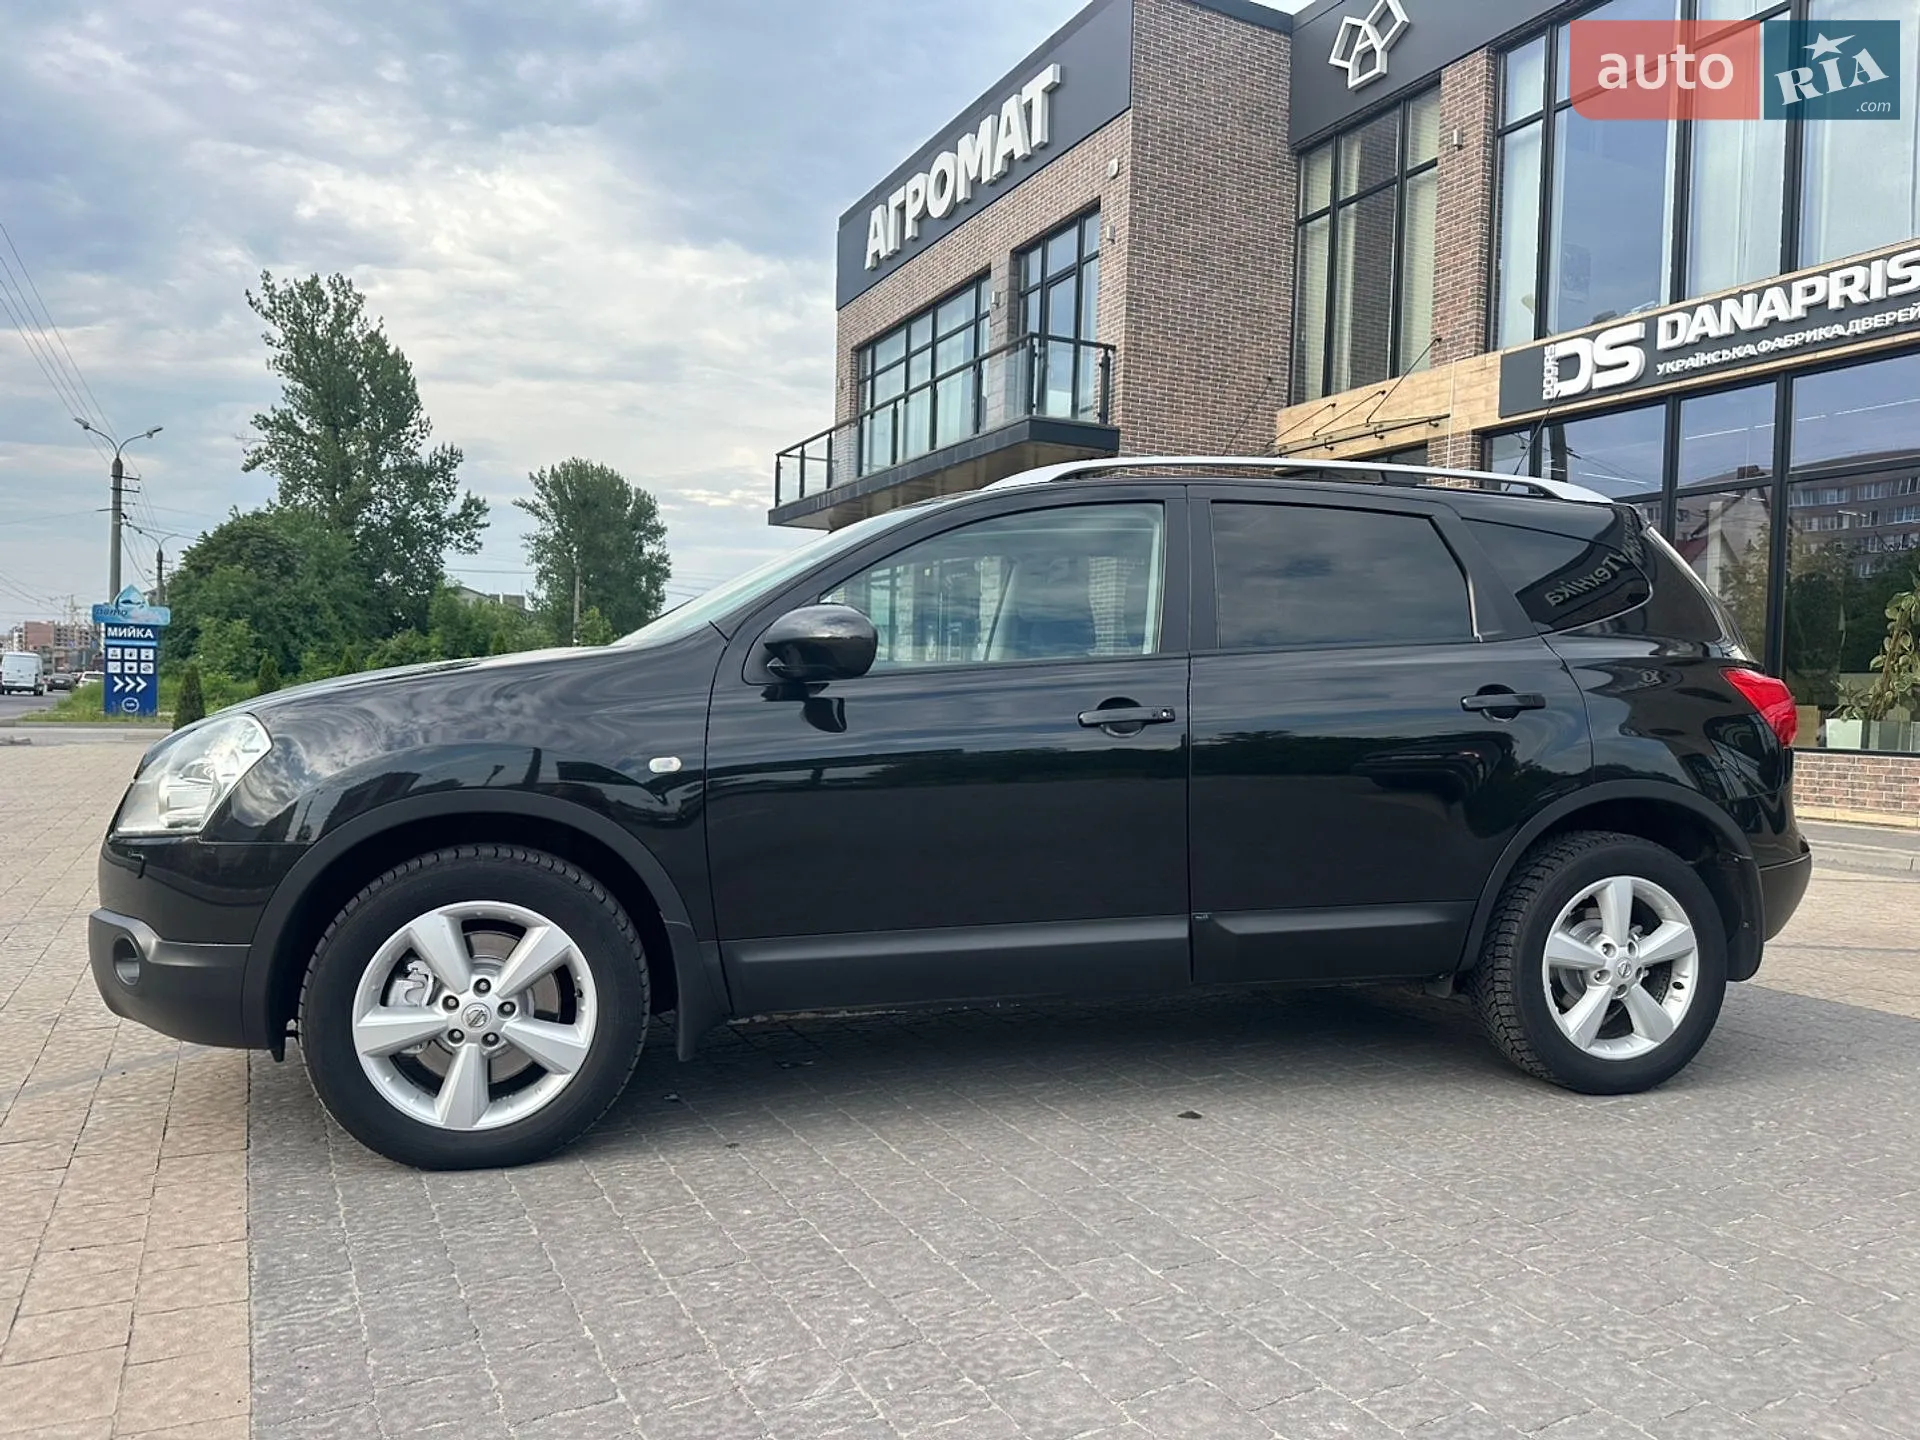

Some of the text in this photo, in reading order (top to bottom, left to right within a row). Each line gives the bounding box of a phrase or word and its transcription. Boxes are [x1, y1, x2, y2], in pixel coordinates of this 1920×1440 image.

[864, 63, 1062, 271] АГРОМАТ
[1542, 344, 1560, 401] DOORS
[1655, 302, 1920, 377] УКРАЇНСЬКА ФАБРИКА ДВЕРЕЙ
[108, 626, 154, 639] МИЙКА
